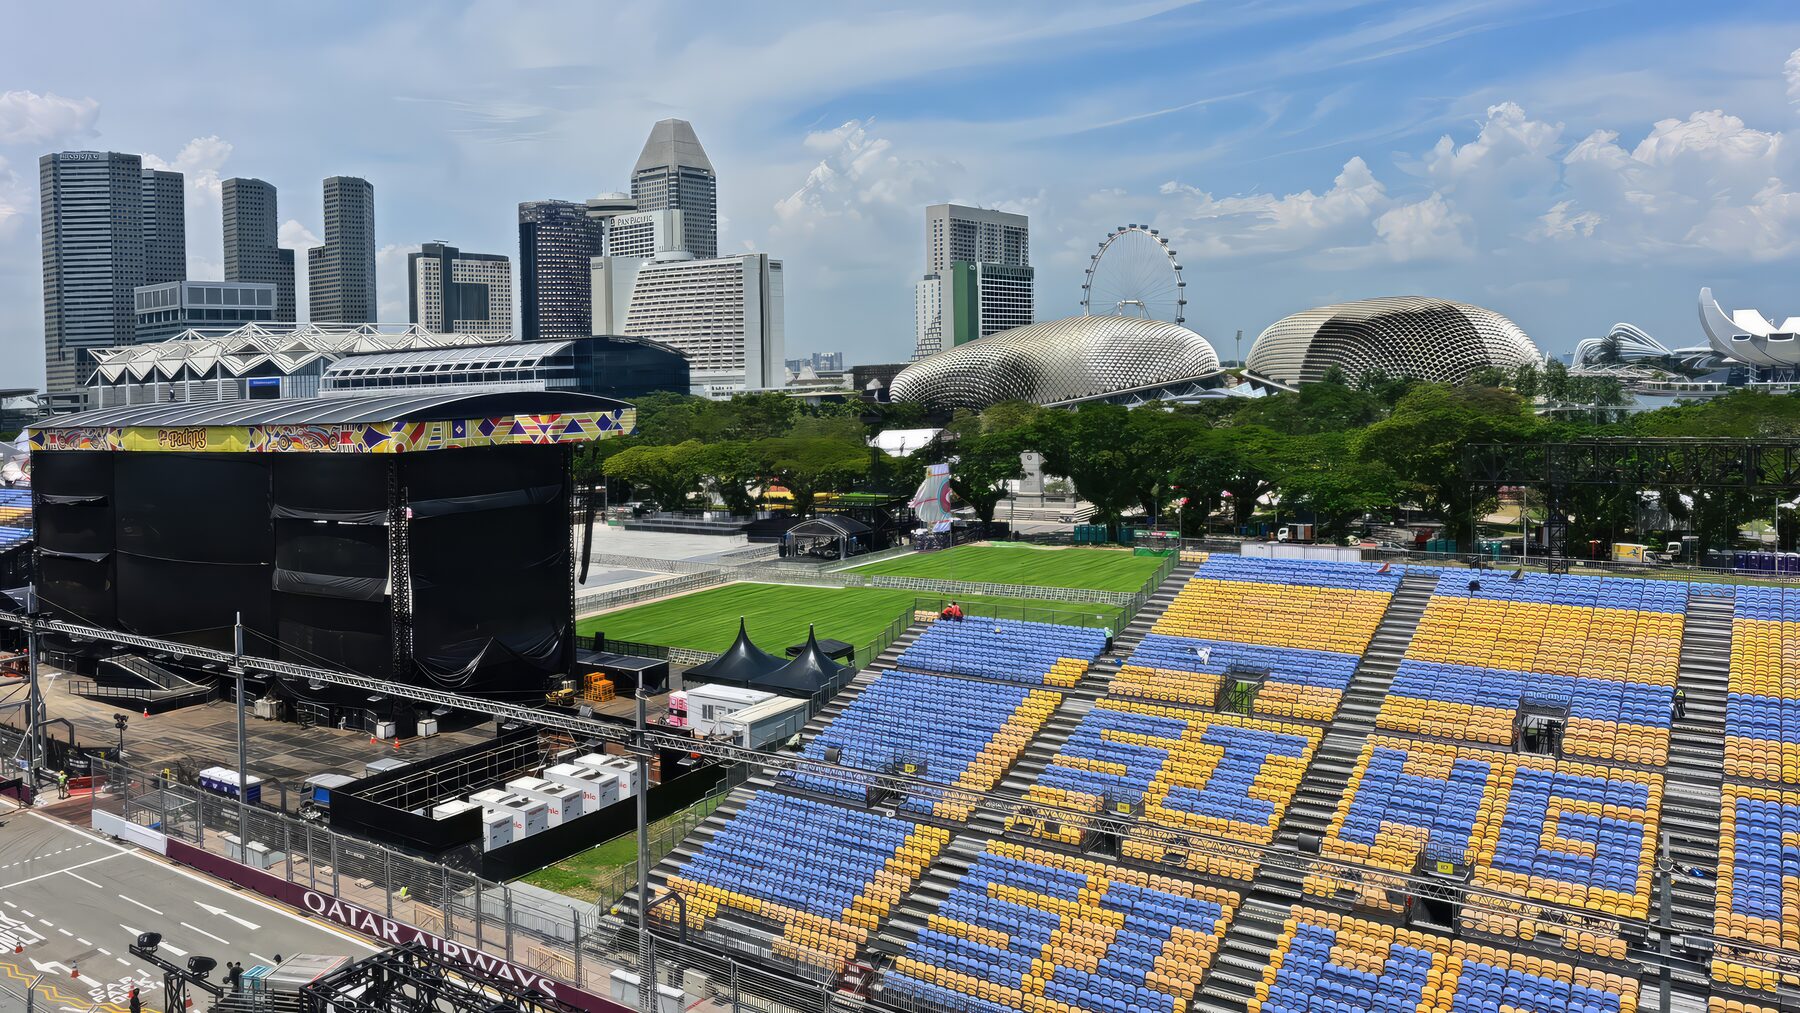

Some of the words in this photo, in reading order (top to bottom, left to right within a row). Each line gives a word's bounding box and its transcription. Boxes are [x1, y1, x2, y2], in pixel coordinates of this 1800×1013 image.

[617, 218, 629, 226] PAN
[168, 427, 207, 449] Padang
[303, 891, 400, 944] QATAR
[411, 931, 557, 999] AIRWAYS
